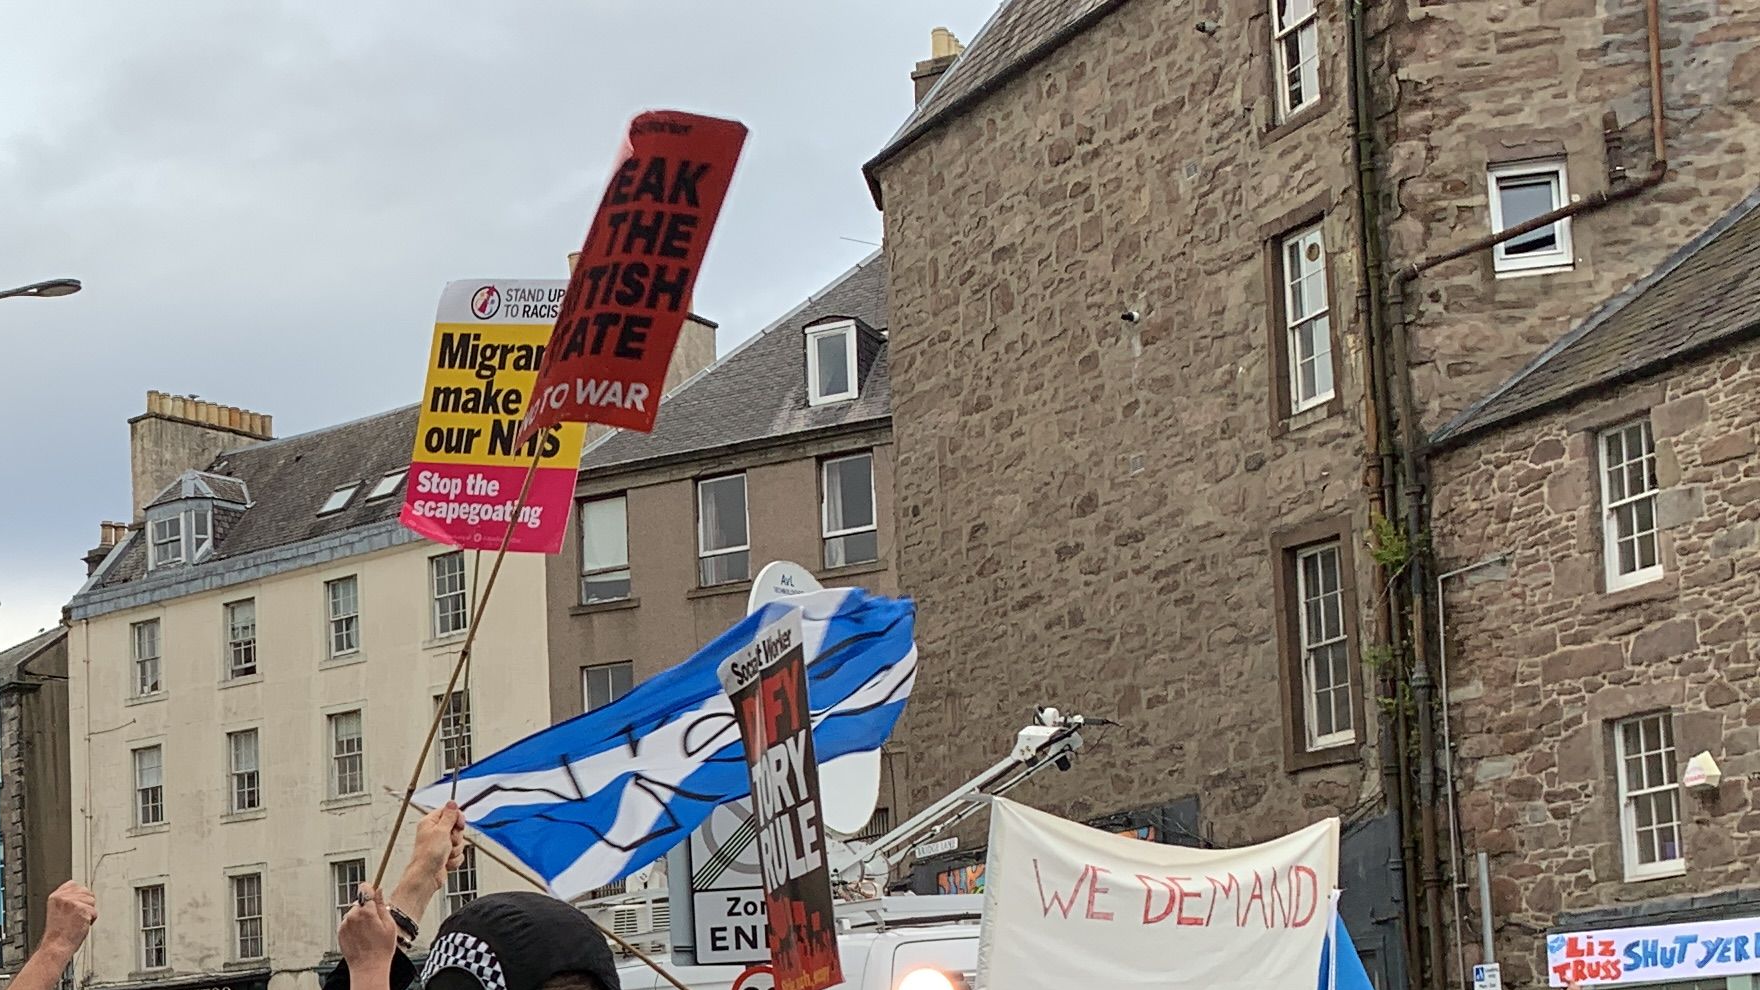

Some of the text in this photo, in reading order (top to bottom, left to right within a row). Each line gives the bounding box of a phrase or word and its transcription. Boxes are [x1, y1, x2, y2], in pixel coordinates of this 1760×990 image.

[608, 157, 712, 208] EAK
[605, 210, 698, 260] THE
[504, 304, 559, 319] TO RACIS
[505, 288, 566, 303] STAND UP
[437, 331, 546, 380] Migran
[429, 379, 523, 416] make
[539, 383, 570, 414] TO
[575, 378, 650, 413] WAR
[424, 425, 482, 455] our
[416, 470, 500, 500] Stop the
[760, 628, 792, 664] Worker
[751, 727, 809, 828] TORY
[757, 799, 823, 895] RULE
[1032, 858, 1319, 929] WE DEMAND
[1552, 958, 1623, 983] TRUSS
[1623, 933, 1698, 972] SHUT
[1696, 935, 1751, 969] YER
